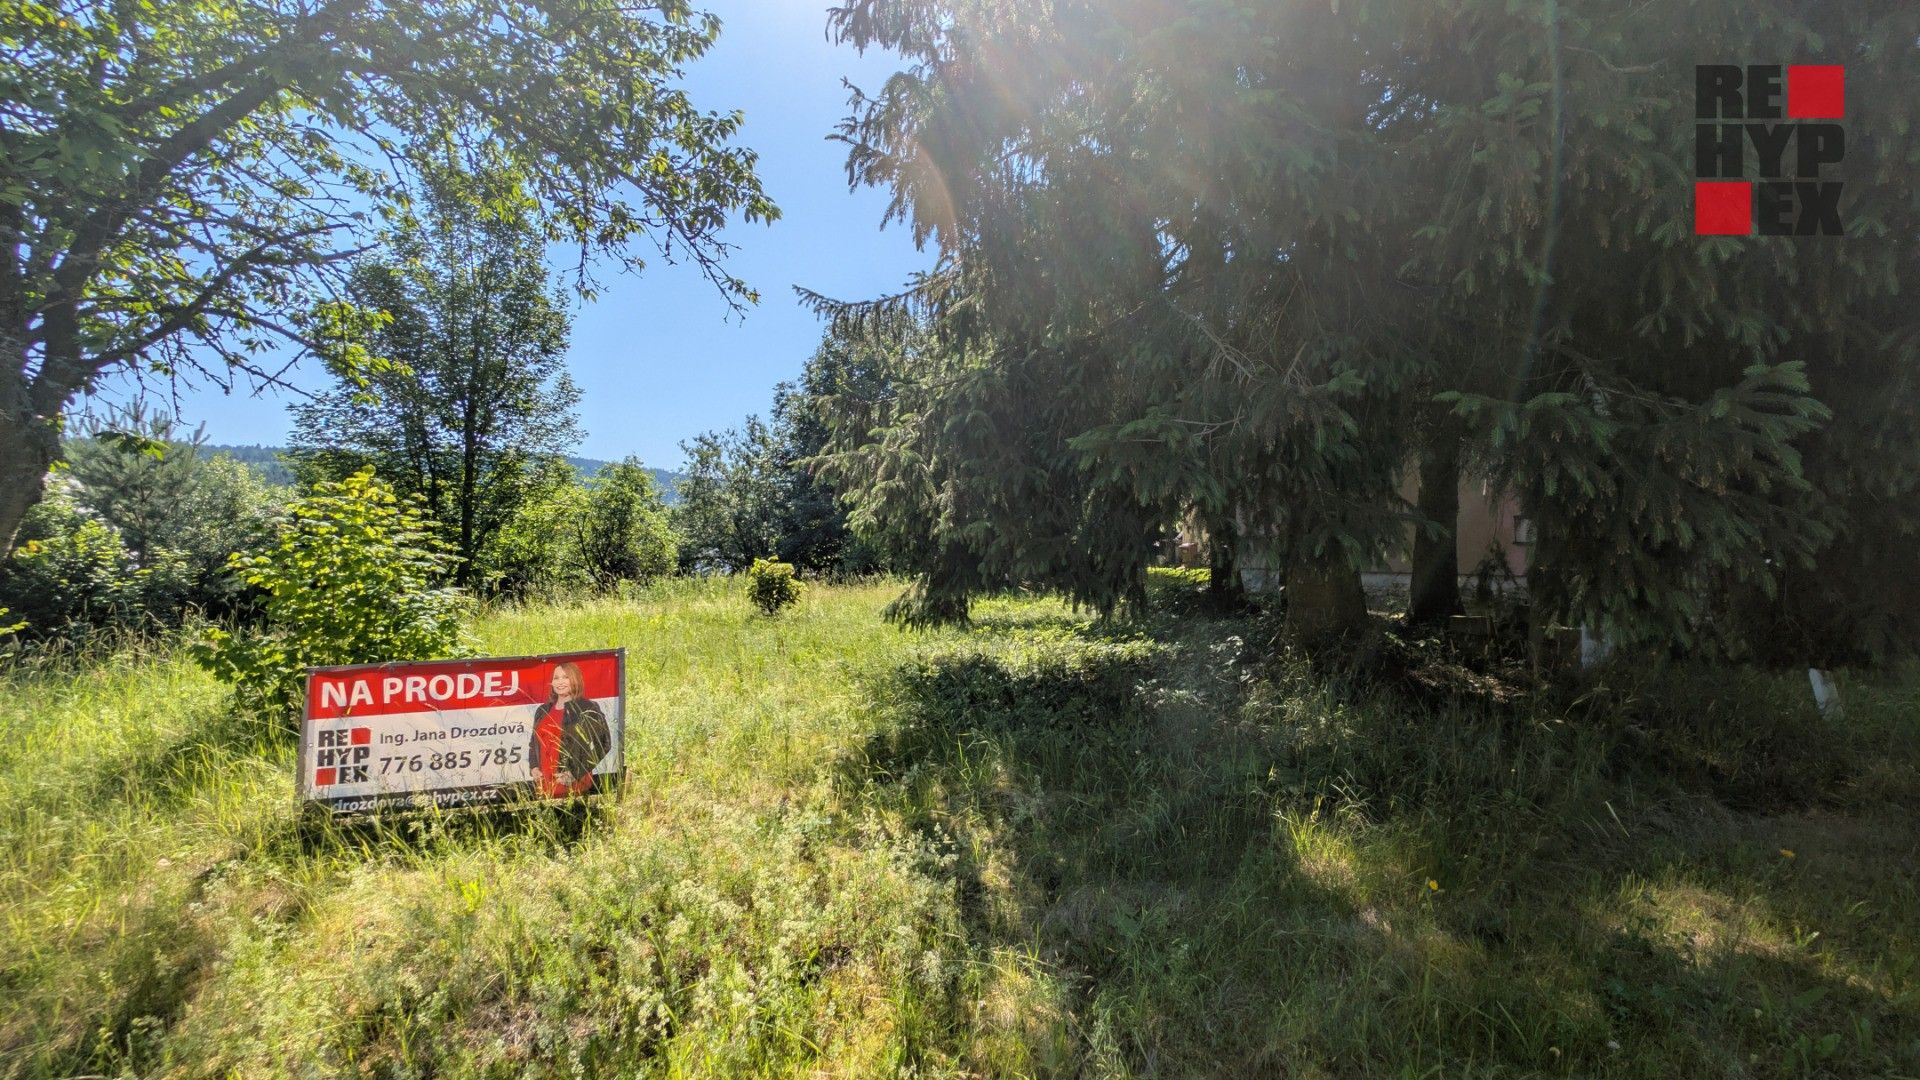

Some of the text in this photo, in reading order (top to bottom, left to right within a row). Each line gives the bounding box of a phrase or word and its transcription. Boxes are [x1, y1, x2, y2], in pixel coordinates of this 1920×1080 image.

[321, 670, 520, 708] NA PRODEJ
[318, 729, 348, 747] RE
[380, 722, 525, 746] Ing. Jana Drozdová
[317, 747, 370, 767] HYP
[380, 746, 522, 775] 776 885 785
[339, 765, 368, 784] EX
[333, 789, 497, 811] drozdova@ehypex.cz
